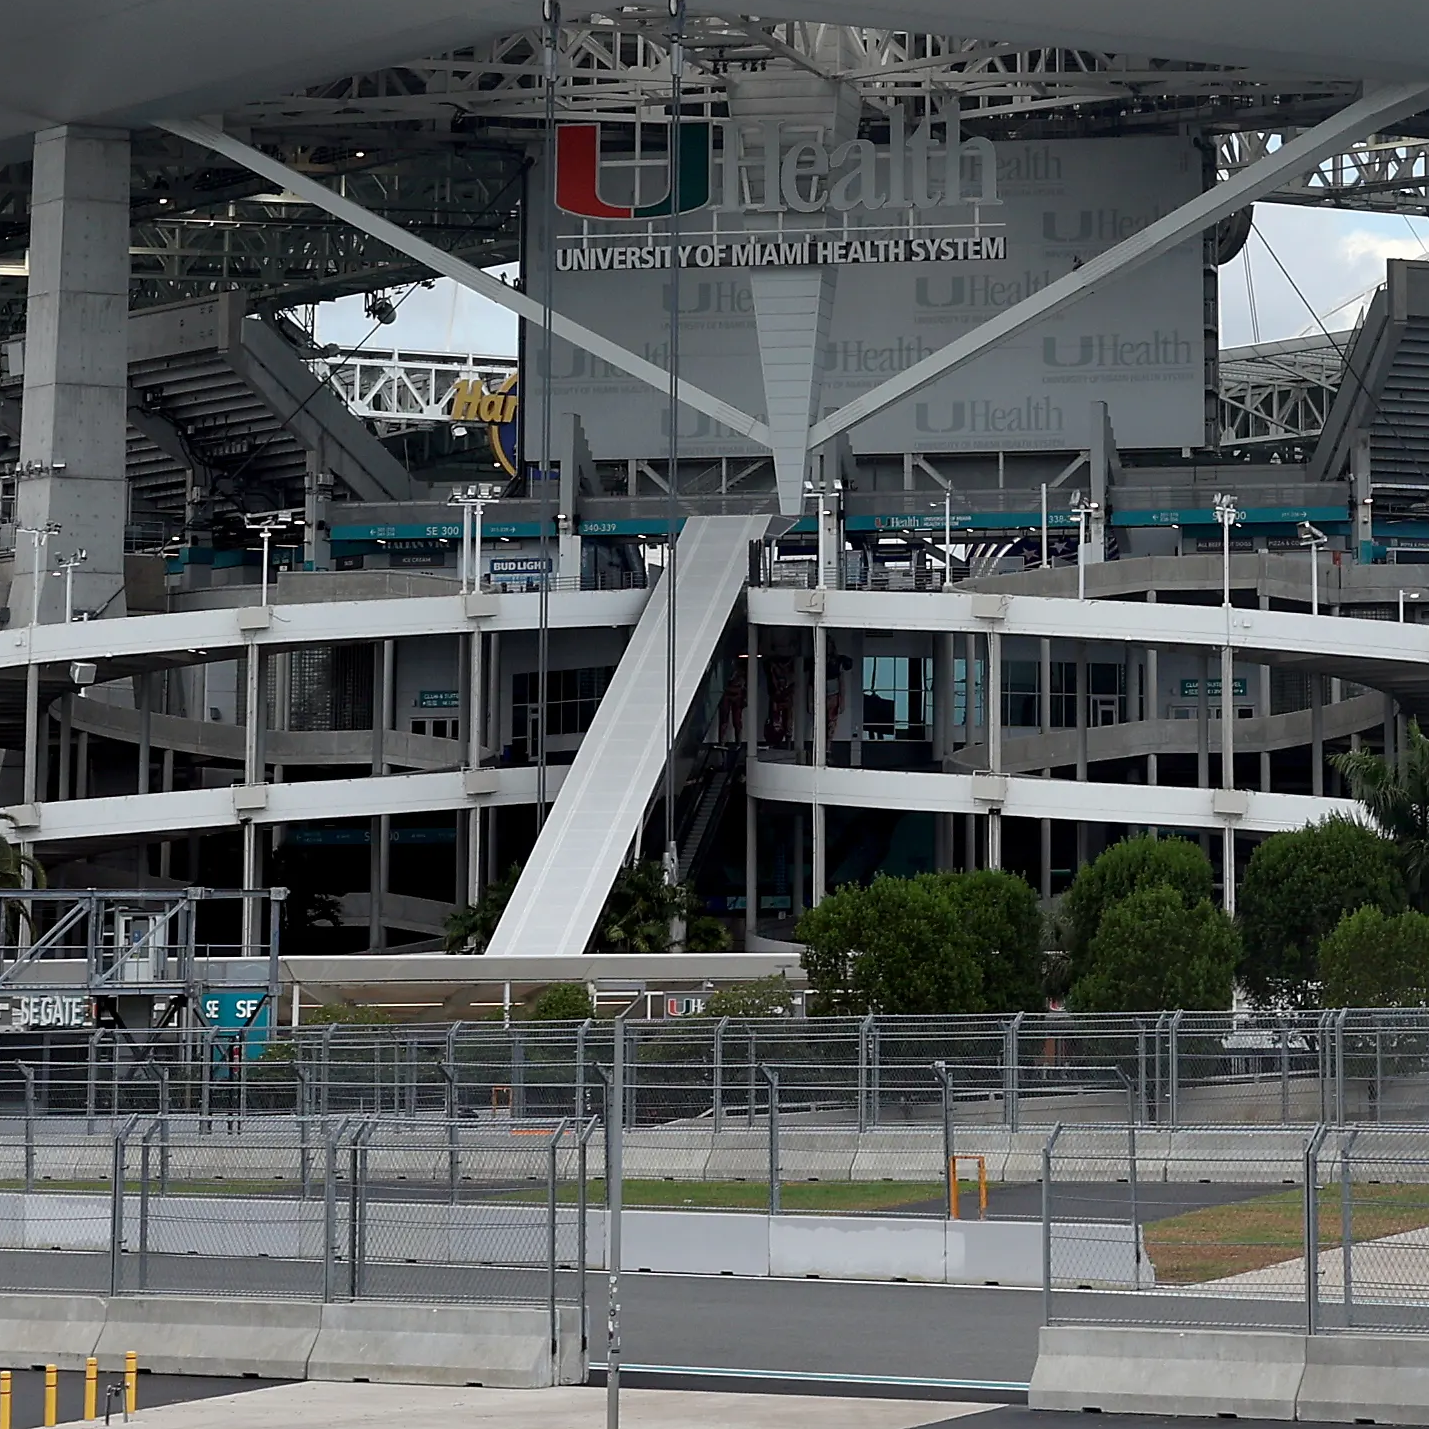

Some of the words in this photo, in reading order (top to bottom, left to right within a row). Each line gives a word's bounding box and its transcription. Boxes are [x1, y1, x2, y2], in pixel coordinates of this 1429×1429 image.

[556, 243, 696, 271] UNIVERSITY
[696, 241, 726, 267] OF
[731, 239, 809, 267] MIAMI
[818, 238, 906, 264] HEALTH
[910, 235, 1006, 261] SYSTEM
[451, 379, 517, 423] Har
[425, 526, 438, 536] SE
[441, 526, 460, 536] 300
[583, 523, 617, 532] 340-339
[493, 561, 516, 571] BUD
[20, 998, 40, 1027] SE
[40, 996, 83, 1027] GATE
